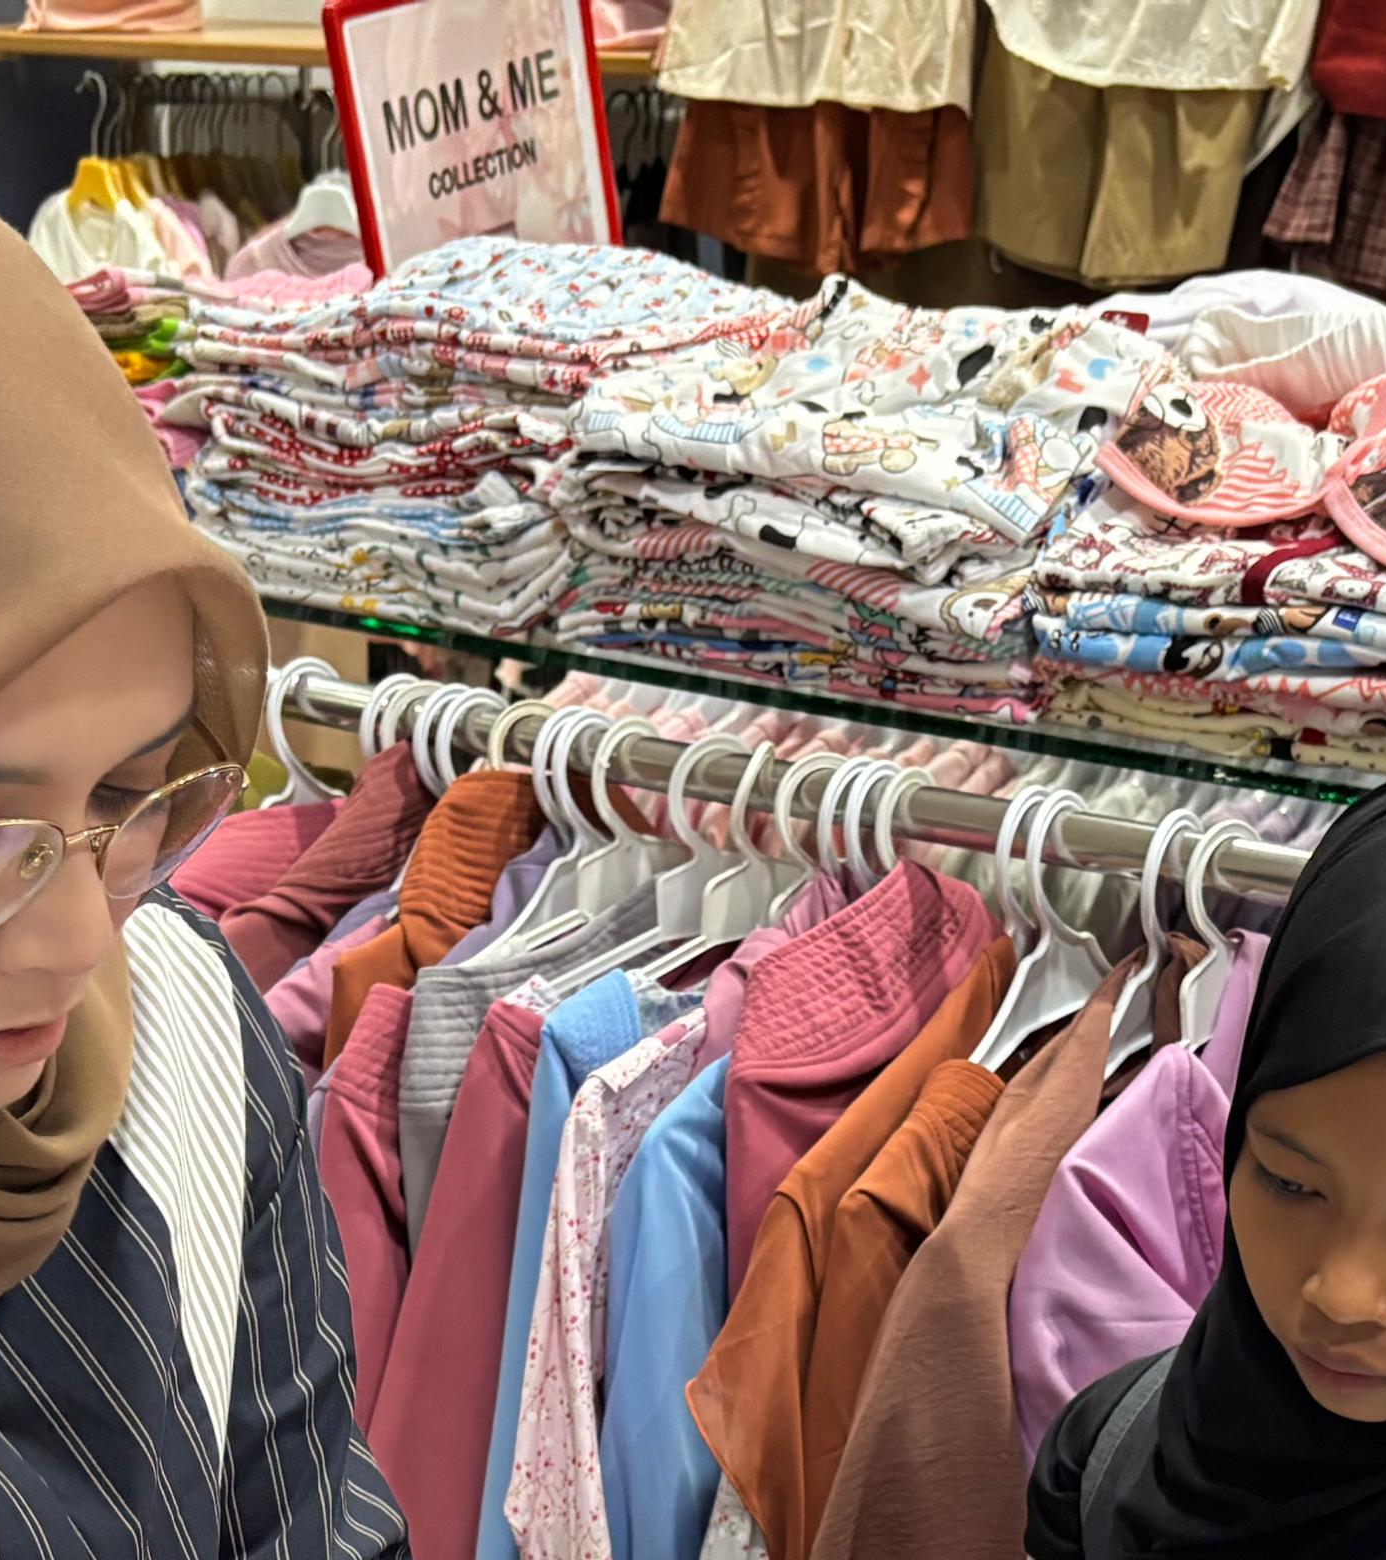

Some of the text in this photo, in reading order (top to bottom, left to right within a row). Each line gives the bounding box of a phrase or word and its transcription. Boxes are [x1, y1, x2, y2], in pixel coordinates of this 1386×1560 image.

[382, 49, 560, 154] MOM & ME
[428, 138, 538, 199] COLLECTION
